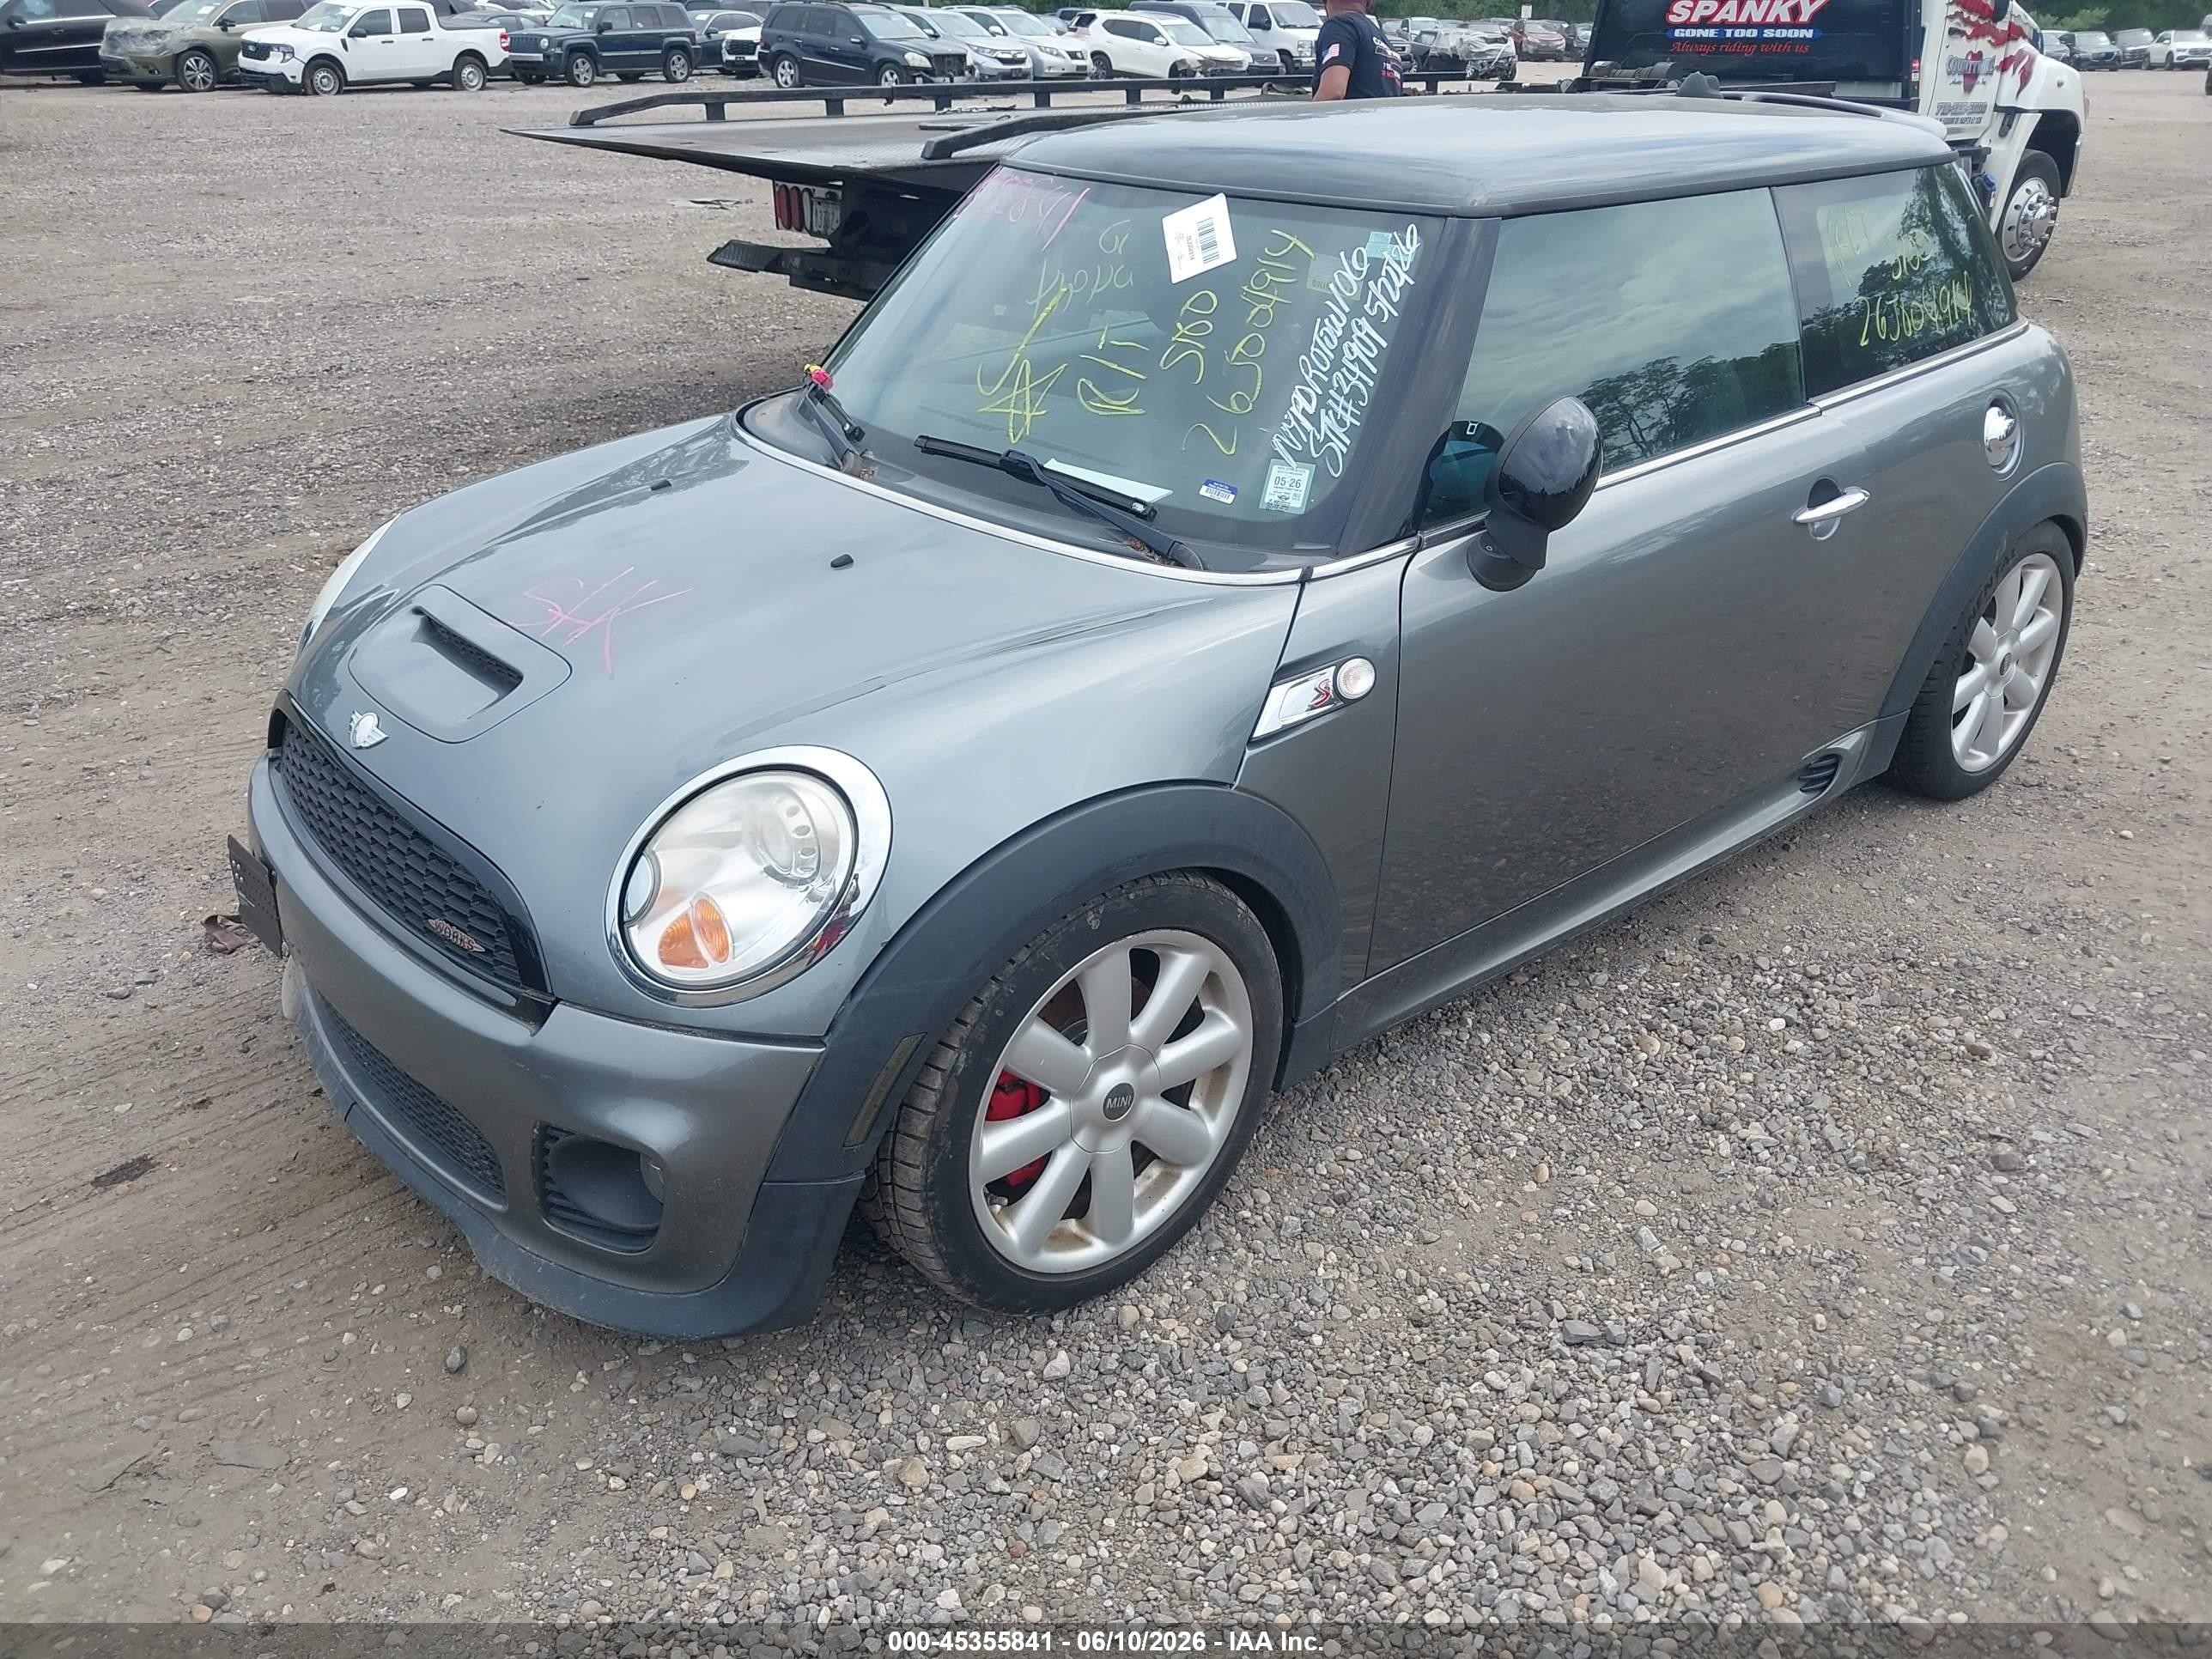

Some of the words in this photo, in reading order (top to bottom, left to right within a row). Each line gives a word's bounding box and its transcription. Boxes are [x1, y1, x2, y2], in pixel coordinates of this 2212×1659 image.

[1665, 0, 1829, 24] SPANKY
[1674, 28, 1718, 38] GONE
[1724, 28, 1758, 38] TOO
[1763, 28, 1814, 39] SOON
[1670, 41, 1717, 55] Always
[1719, 41, 1757, 55] riding
[1760, 42, 1791, 54] with
[1795, 44, 1810, 54] us
[433, 919, 477, 951] WORKS
[1106, 1095, 1132, 1109] MINI
